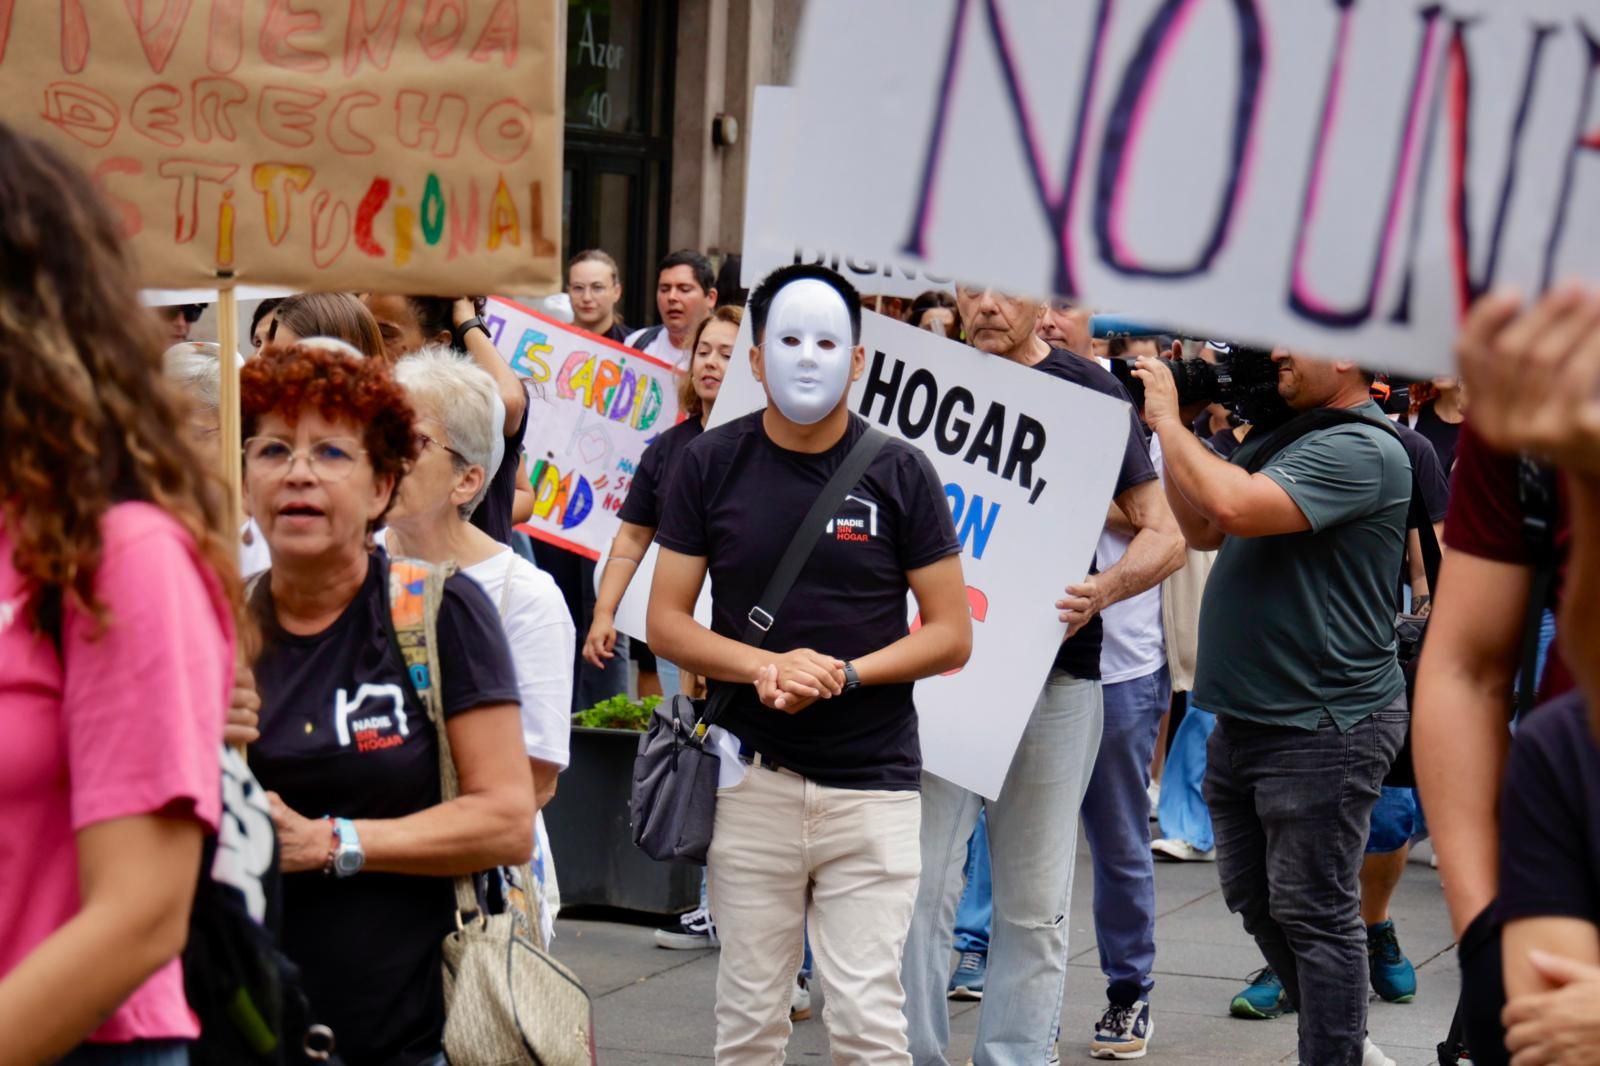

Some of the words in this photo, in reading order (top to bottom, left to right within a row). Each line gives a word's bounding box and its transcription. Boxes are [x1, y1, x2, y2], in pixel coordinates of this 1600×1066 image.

[0, 0, 519, 76] IVIENDA
[41, 77, 534, 163] DERECHO
[587, 91, 612, 129] 40
[898, 0, 1271, 299] NO
[510, 328, 554, 383] ES
[858, 350, 1048, 505] HOGAR,
[837, 519, 864, 528] NADIE
[837, 533, 868, 542] HOGAR
[352, 716, 392, 732] NADIE
[358, 735, 403, 752] HOGAR
